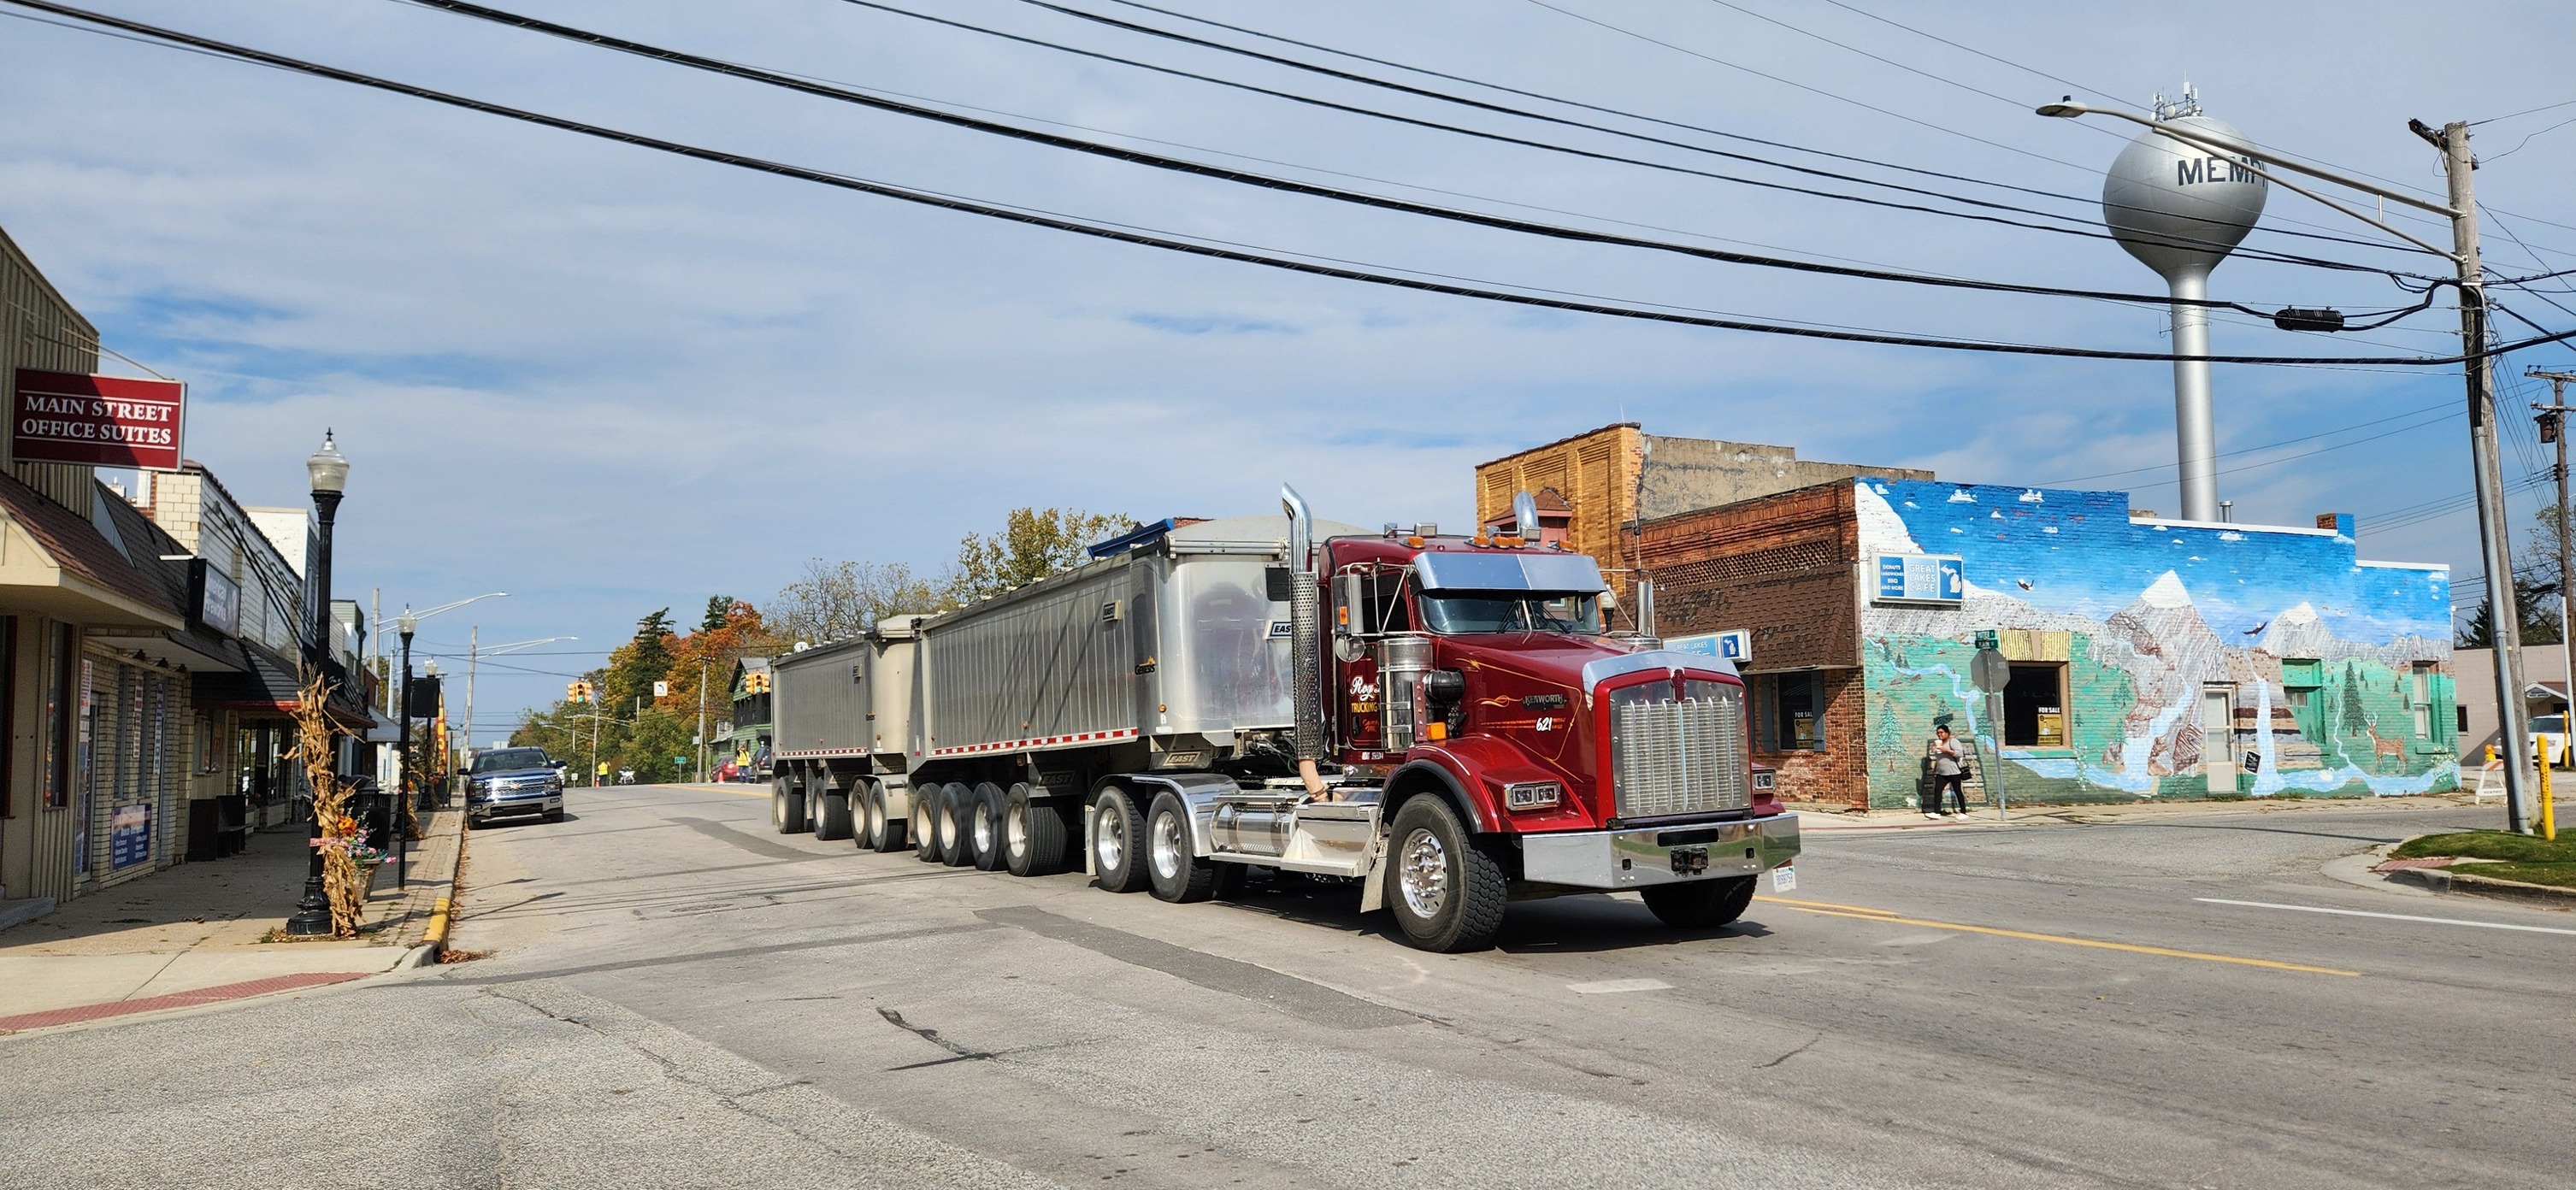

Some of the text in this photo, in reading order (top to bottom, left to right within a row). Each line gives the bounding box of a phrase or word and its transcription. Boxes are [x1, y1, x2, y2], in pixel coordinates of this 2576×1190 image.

[25, 395, 172, 422] MAIN STREET
[21, 418, 171, 445] OFFICE SUITES
[1908, 563, 1936, 573] GREAT
[1909, 573, 1936, 582] LAKES
[1909, 582, 1936, 592] CAFE
[1104, 607, 1114, 616] EAST
[1274, 625, 1292, 633] EAS
[1673, 643, 1689, 651] GREAT
[1525, 694, 1563, 704] KENWORTH
[1351, 702, 1378, 713] TRUCKING
[1536, 716, 1553, 732] 621
[1042, 775, 1071, 785] EAST
